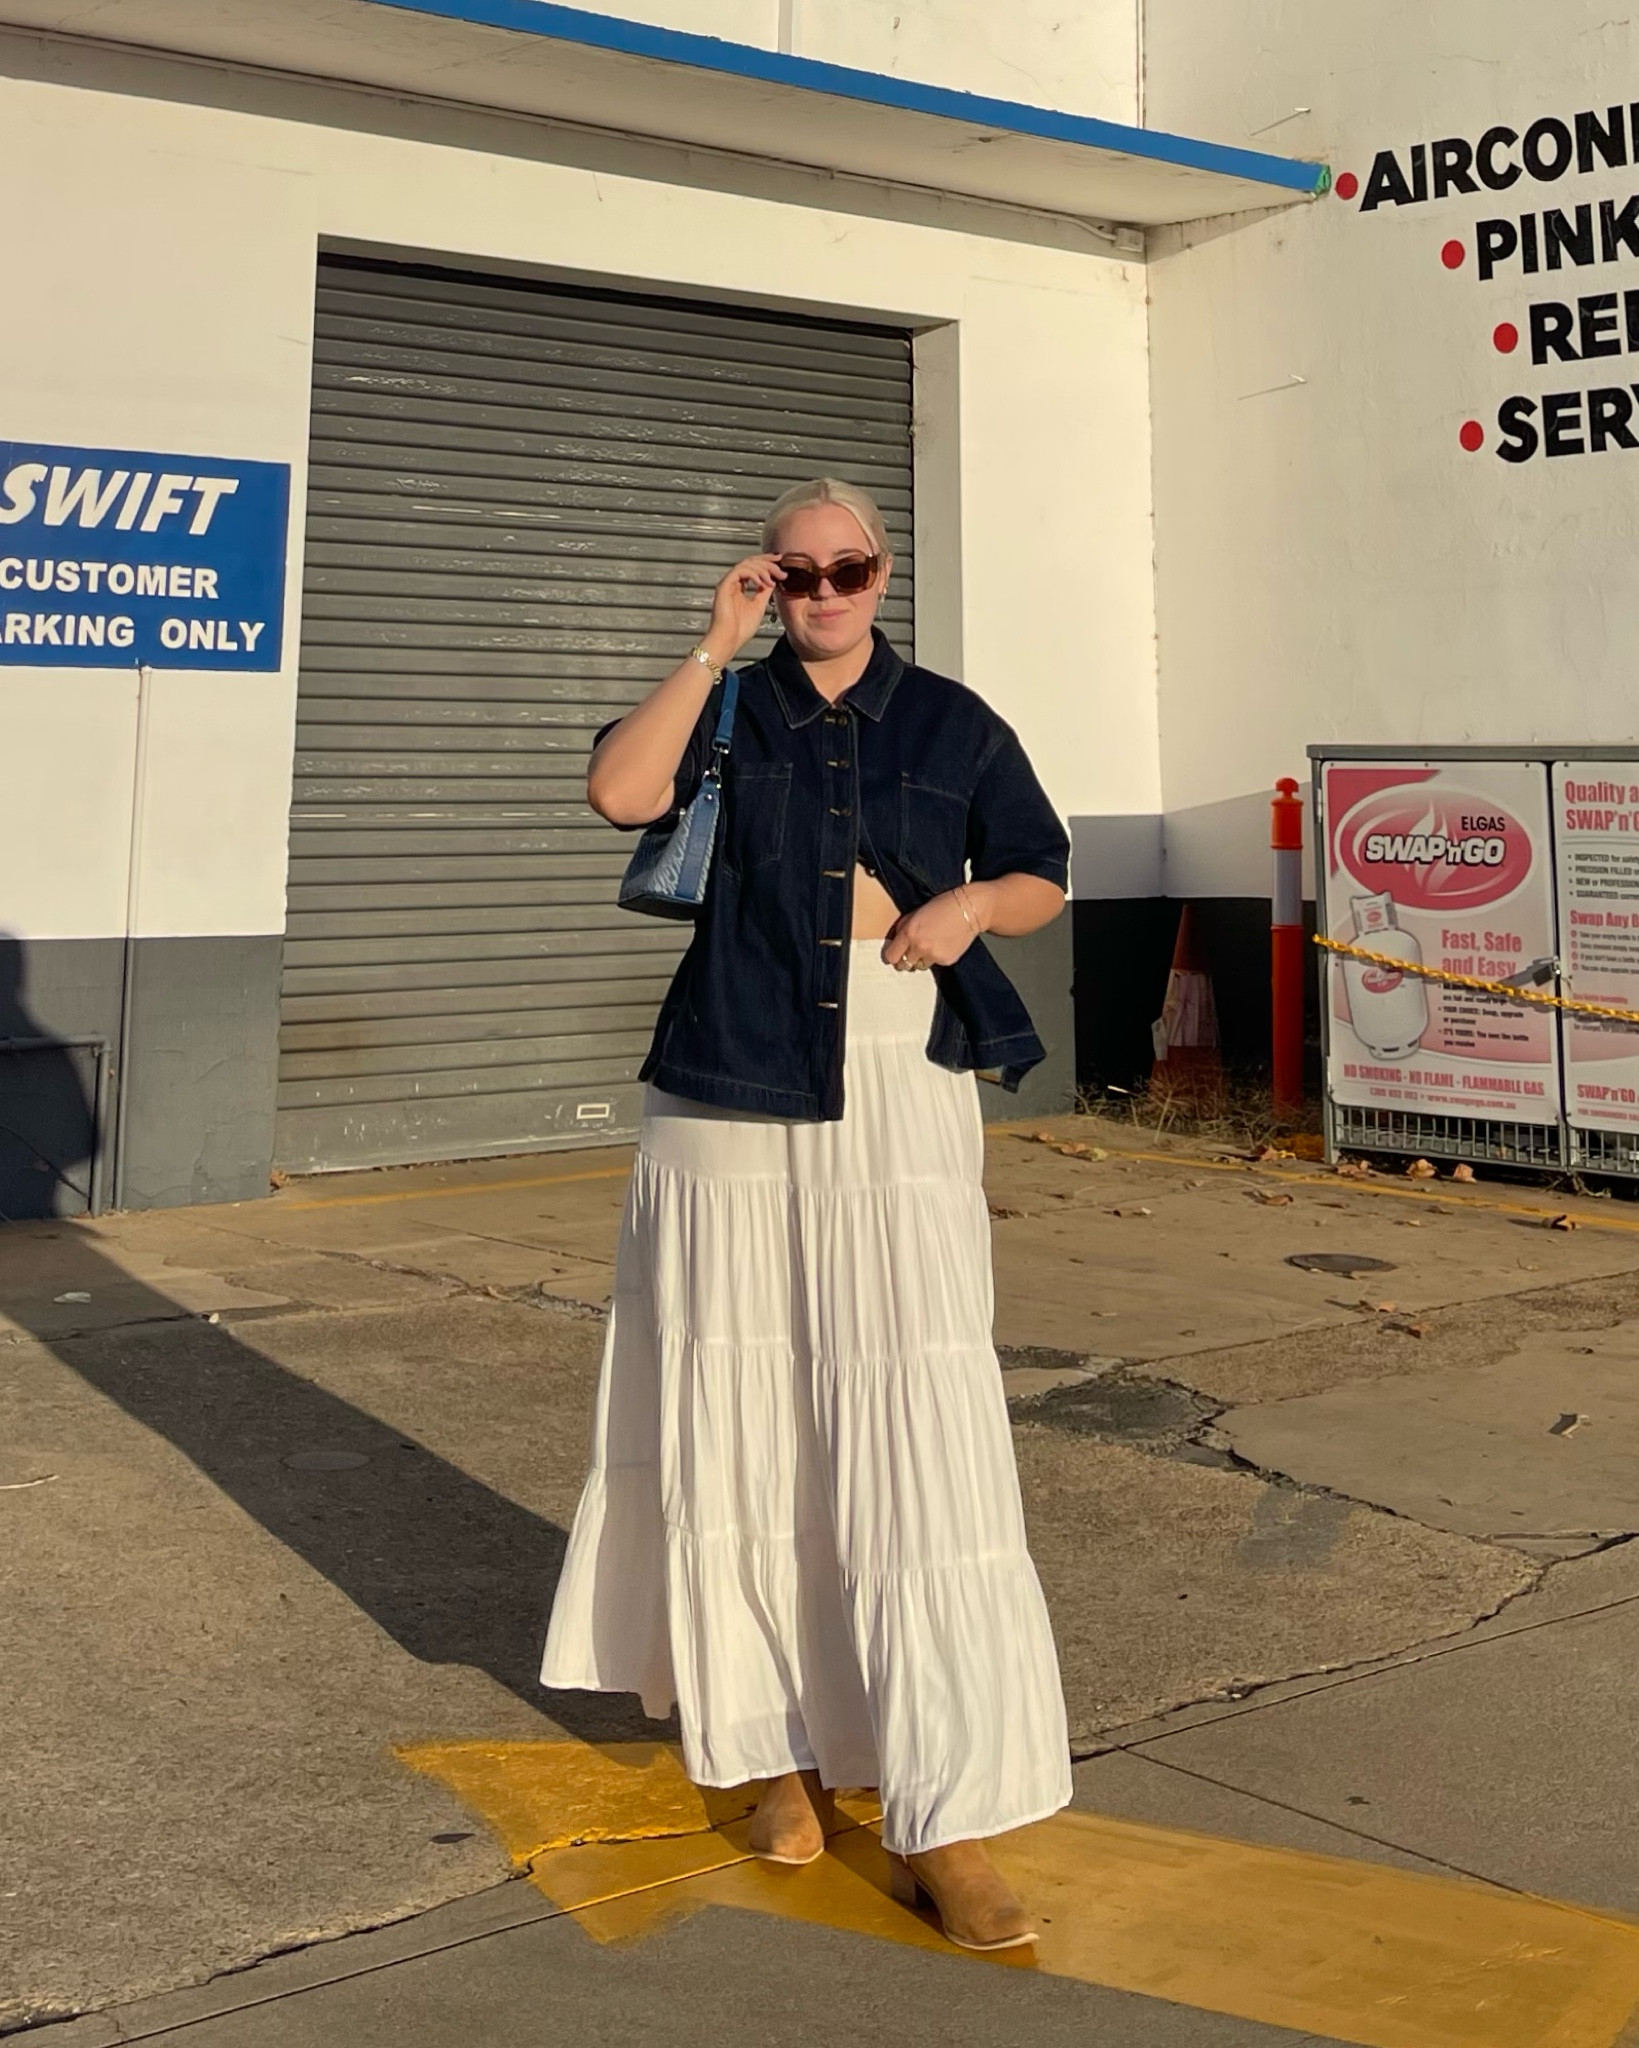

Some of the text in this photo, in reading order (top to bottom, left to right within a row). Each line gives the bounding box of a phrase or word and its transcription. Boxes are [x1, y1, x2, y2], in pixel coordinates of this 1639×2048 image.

[1359, 102, 1639, 212] AIRCON
[1476, 194, 1639, 281] PINK
[1495, 384, 1639, 463] SER
[0, 463, 240, 535] SWIFT
[0, 557, 219, 599] CUSTOMER
[0, 613, 265, 652] RKING ONLY
[1565, 780, 1625, 805] Quality
[1461, 816, 1505, 831] ELGAS
[1570, 909, 1603, 927] Swap
[1606, 911, 1629, 928] Any
[1442, 929, 1522, 952] Fast, Safe
[1442, 956, 1516, 978] and Easy
[1343, 1064, 1545, 1096] NO SMOKING NO FLAME FLAMMABLE GAS
